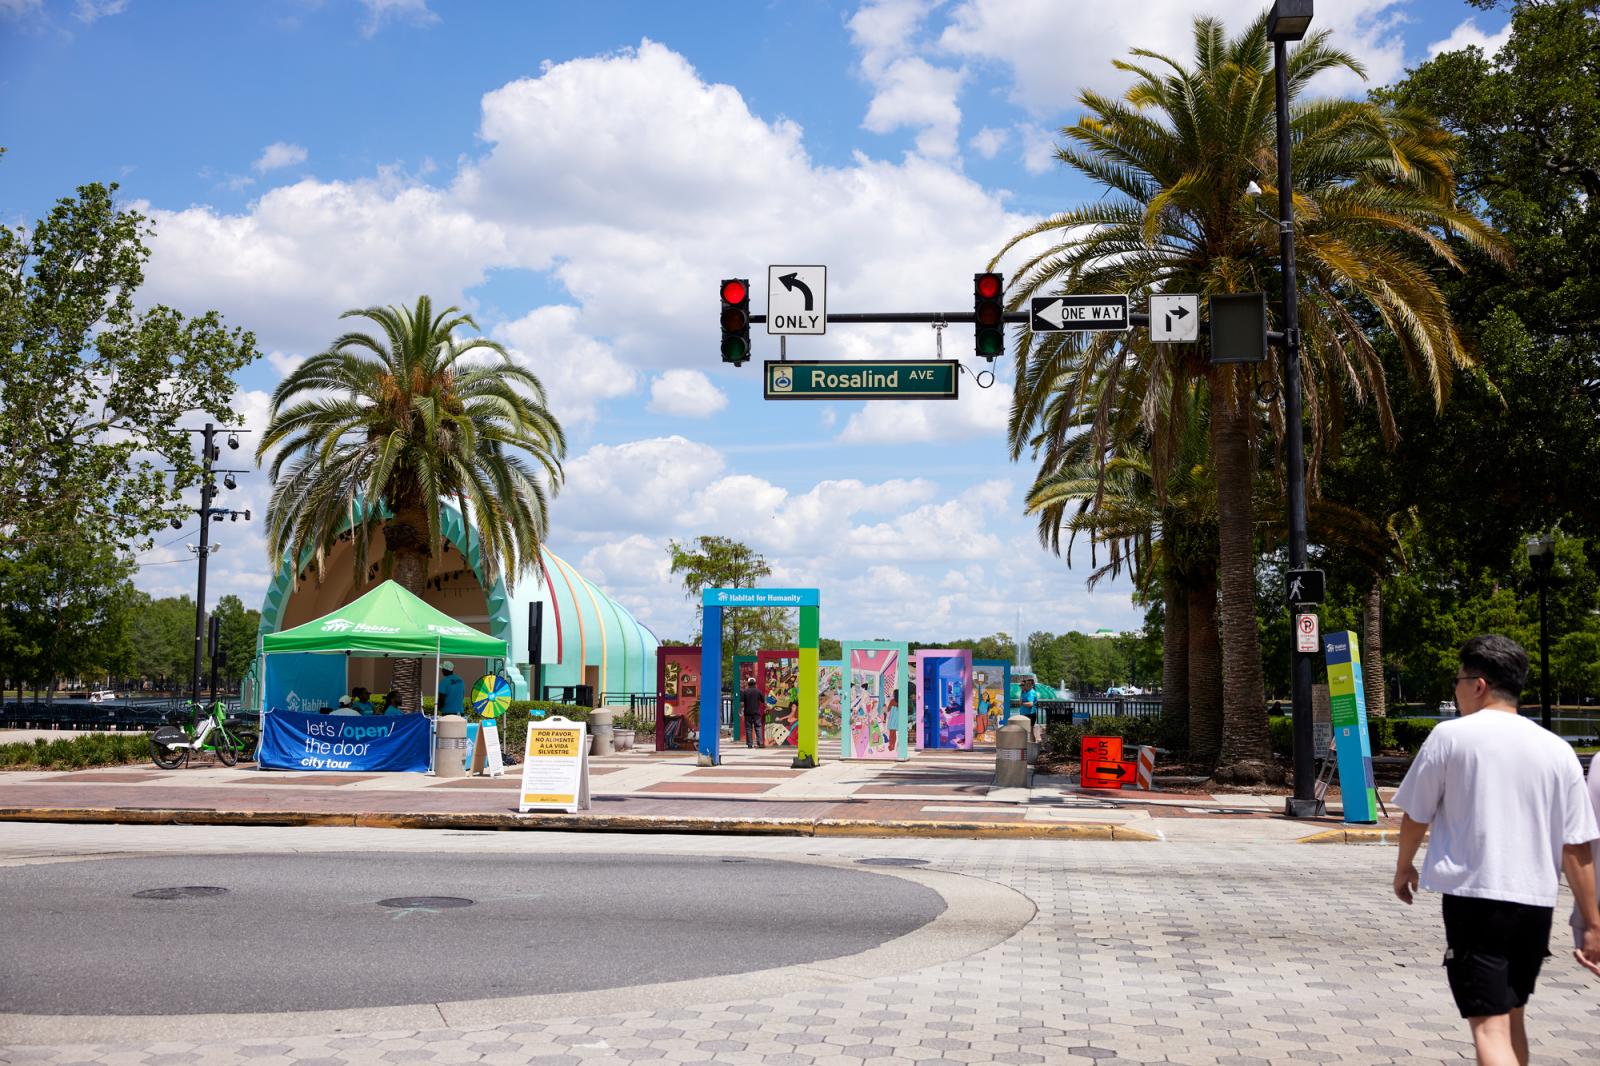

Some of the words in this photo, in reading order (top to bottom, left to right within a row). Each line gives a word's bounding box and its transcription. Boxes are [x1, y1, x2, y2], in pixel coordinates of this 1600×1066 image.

[1061, 307, 1087, 321] ONE
[1092, 305, 1121, 320] WAY
[775, 315, 818, 329] ONLY
[811, 370, 899, 388] Rosalind
[909, 370, 934, 380] AVE
[730, 594, 755, 602] Habitat
[757, 594, 766, 602] for
[767, 594, 801, 603] Humanity
[306, 719, 335, 737] let's
[305, 737, 330, 755] the
[333, 739, 370, 756] door
[301, 756, 324, 769] city
[326, 758, 352, 769] tour
